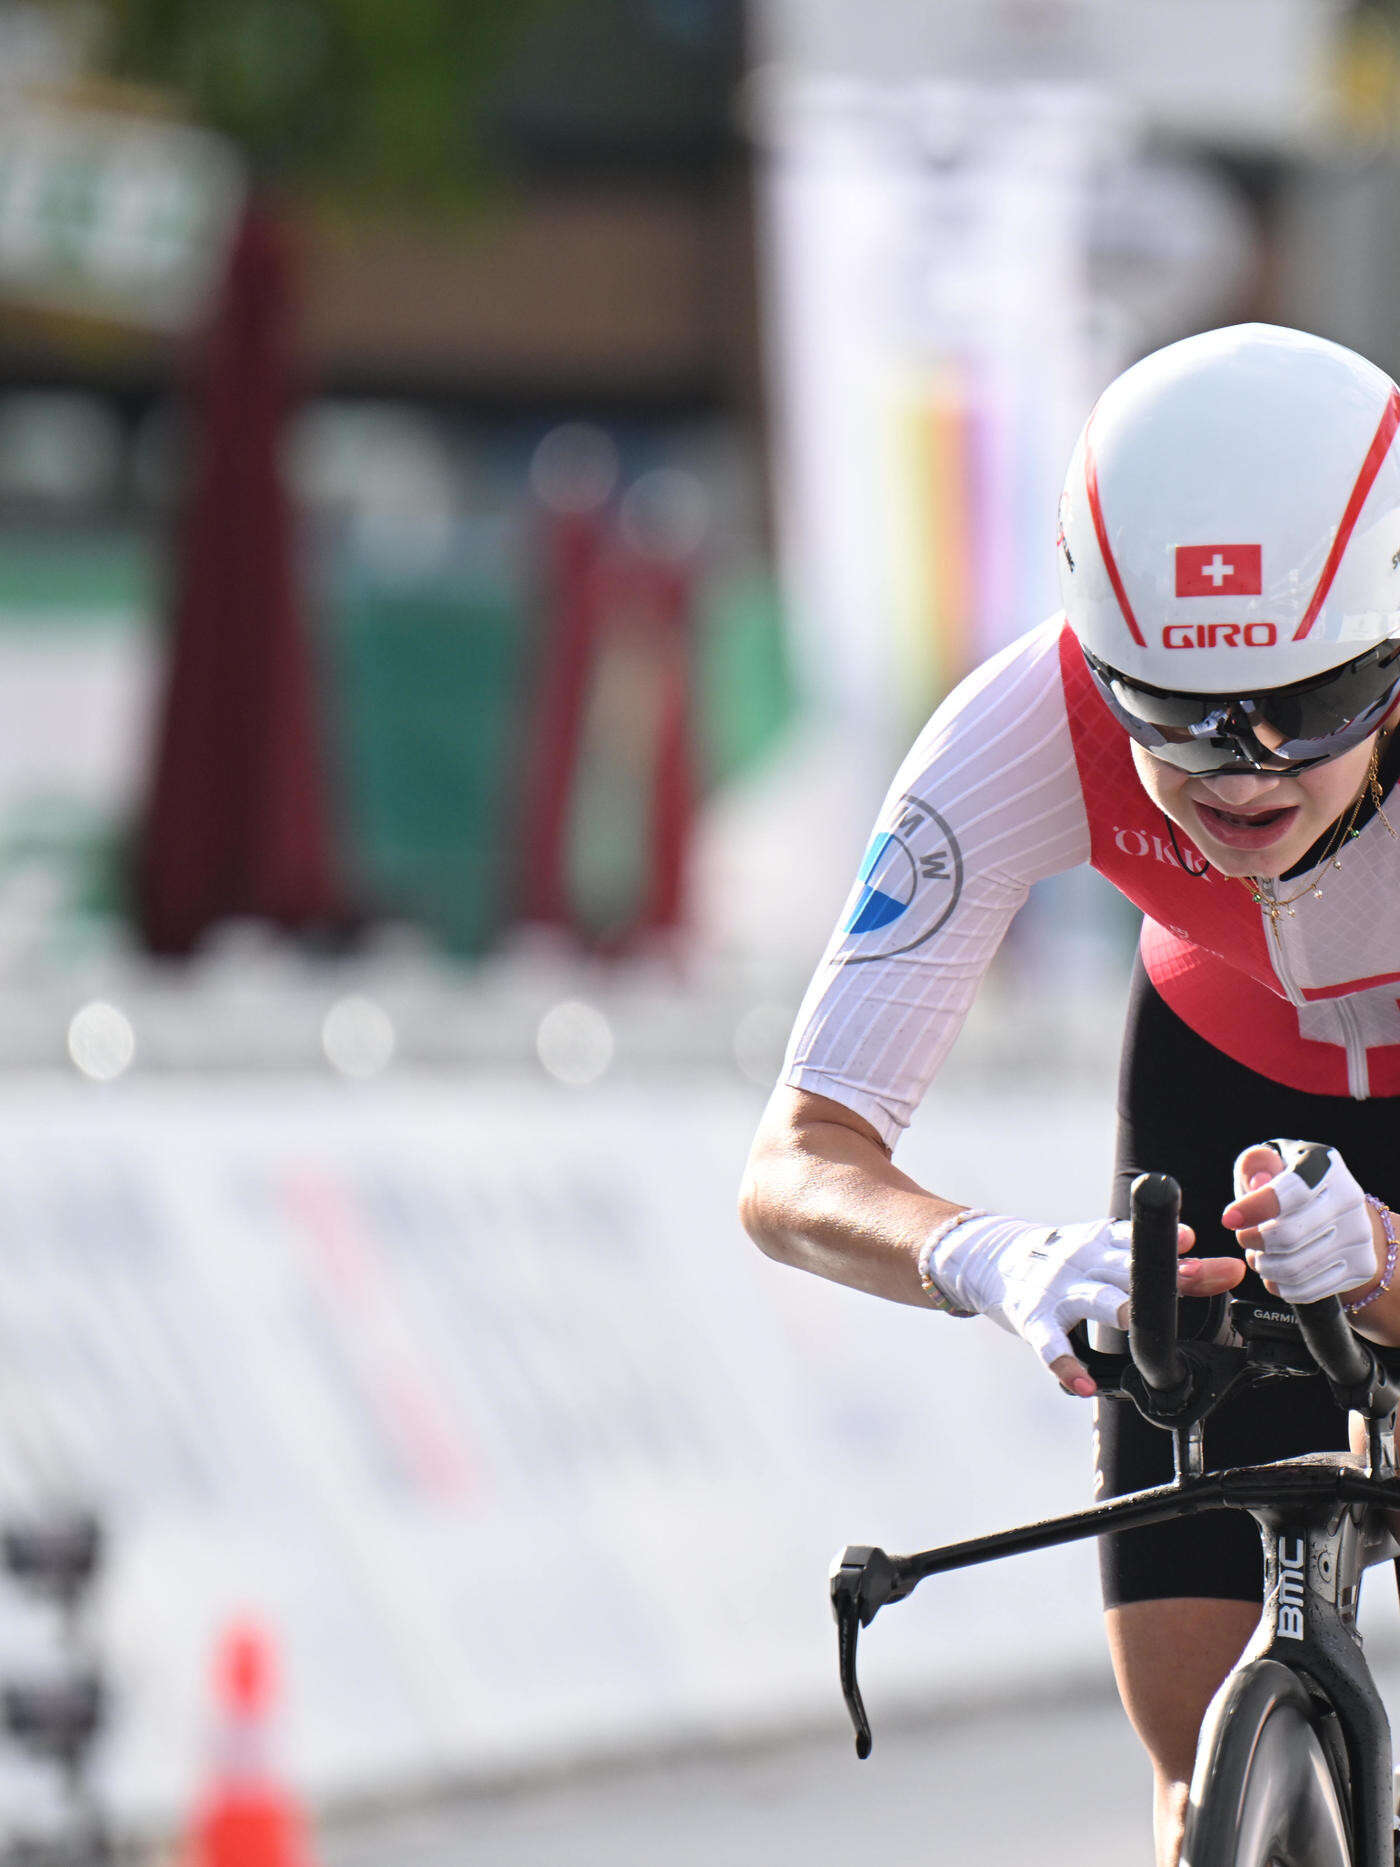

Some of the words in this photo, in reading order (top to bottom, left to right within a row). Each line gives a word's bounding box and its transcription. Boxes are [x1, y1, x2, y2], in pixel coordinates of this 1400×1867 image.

[1162, 622, 1277, 649] GIRO
[1253, 1309, 1299, 1324] GARMI
[1277, 1535, 1304, 1641] BMC
